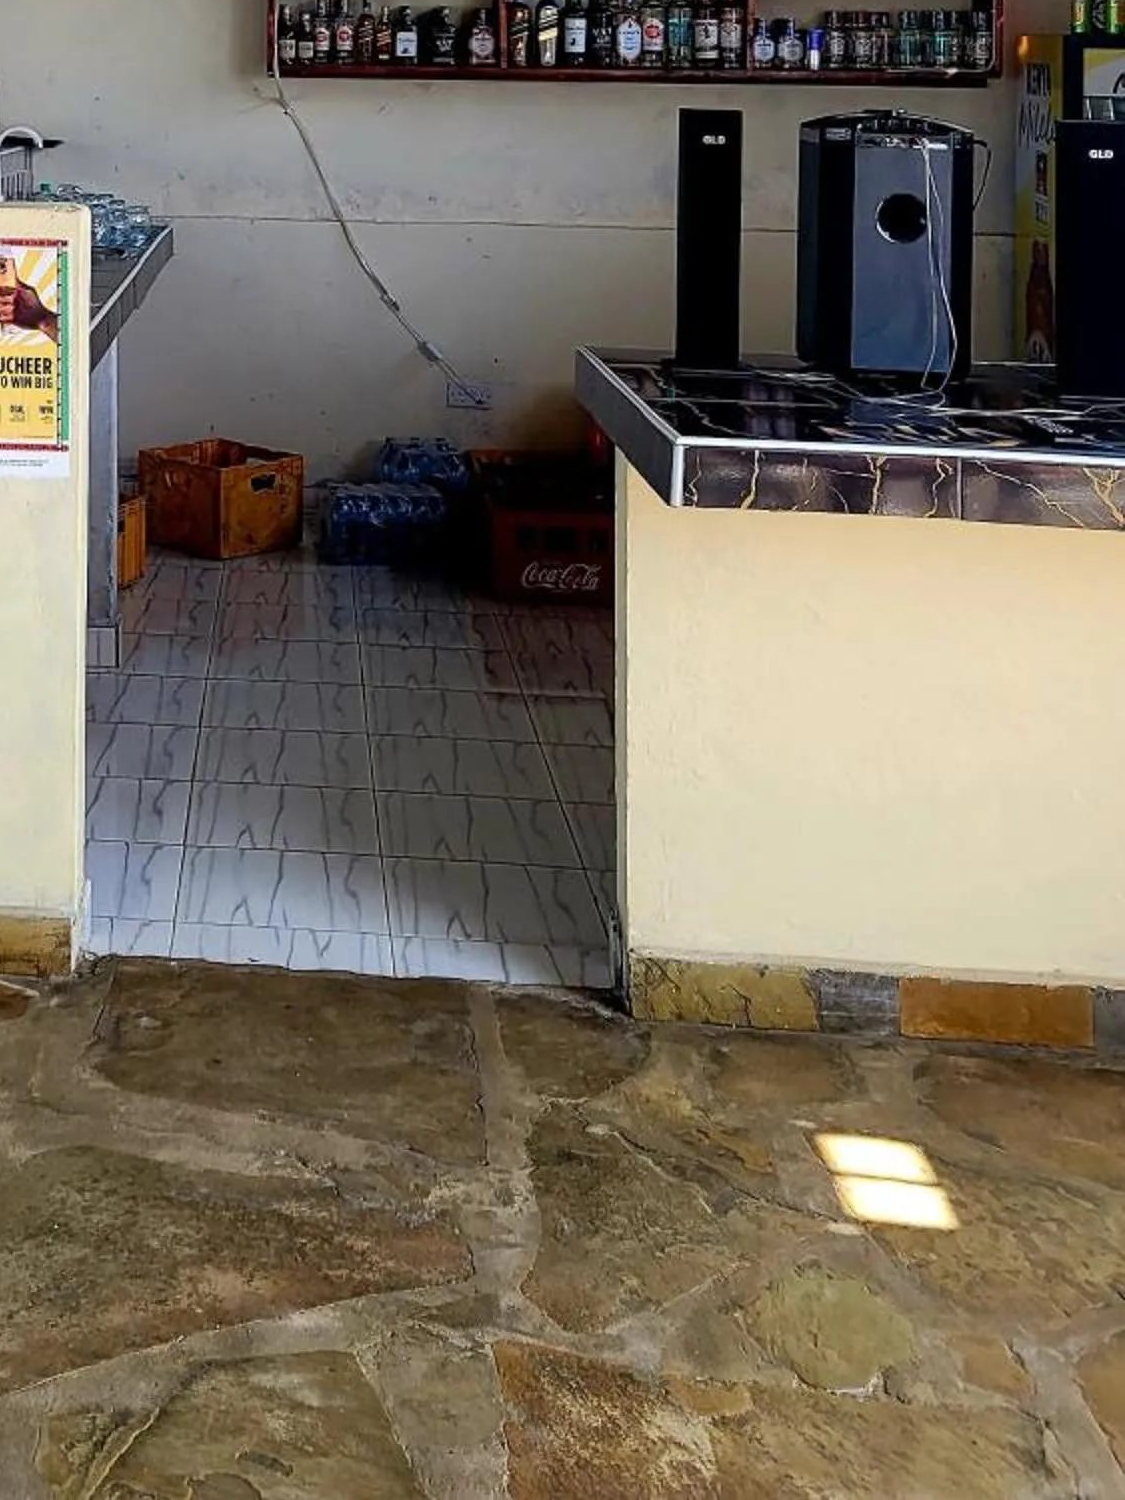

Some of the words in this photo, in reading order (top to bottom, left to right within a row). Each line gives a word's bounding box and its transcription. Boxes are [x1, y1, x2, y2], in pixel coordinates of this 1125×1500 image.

[1088, 149, 1115, 159] GLD
[10, 375, 32, 389] WIN
[34, 376, 53, 389] BIG
[521, 560, 602, 592] Coca-Cola
